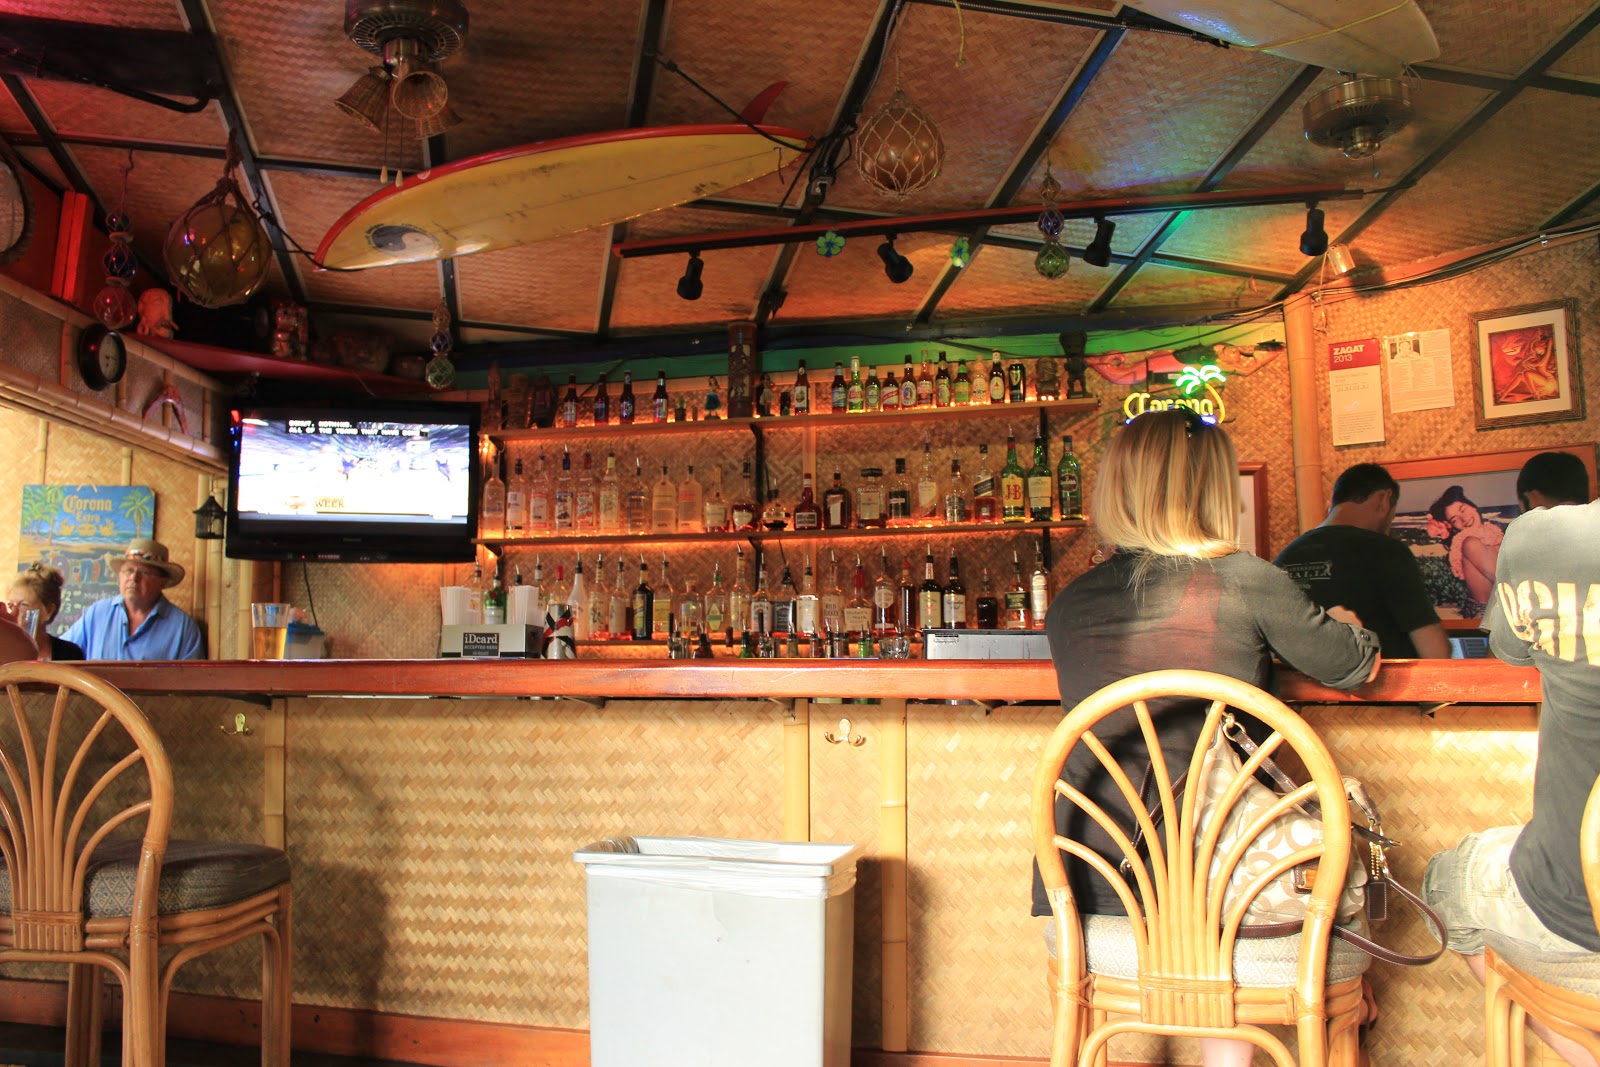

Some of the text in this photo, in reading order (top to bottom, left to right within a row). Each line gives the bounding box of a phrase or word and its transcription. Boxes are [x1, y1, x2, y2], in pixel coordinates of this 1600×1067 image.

[1333, 344, 1365, 355] ZAGAT
[1333, 353, 1353, 363] 2013
[62, 494, 113, 514] Corona
[315, 499, 345, 509] WEEK
[76, 512, 101, 522] Extra
[464, 634, 498, 643] iDcard
